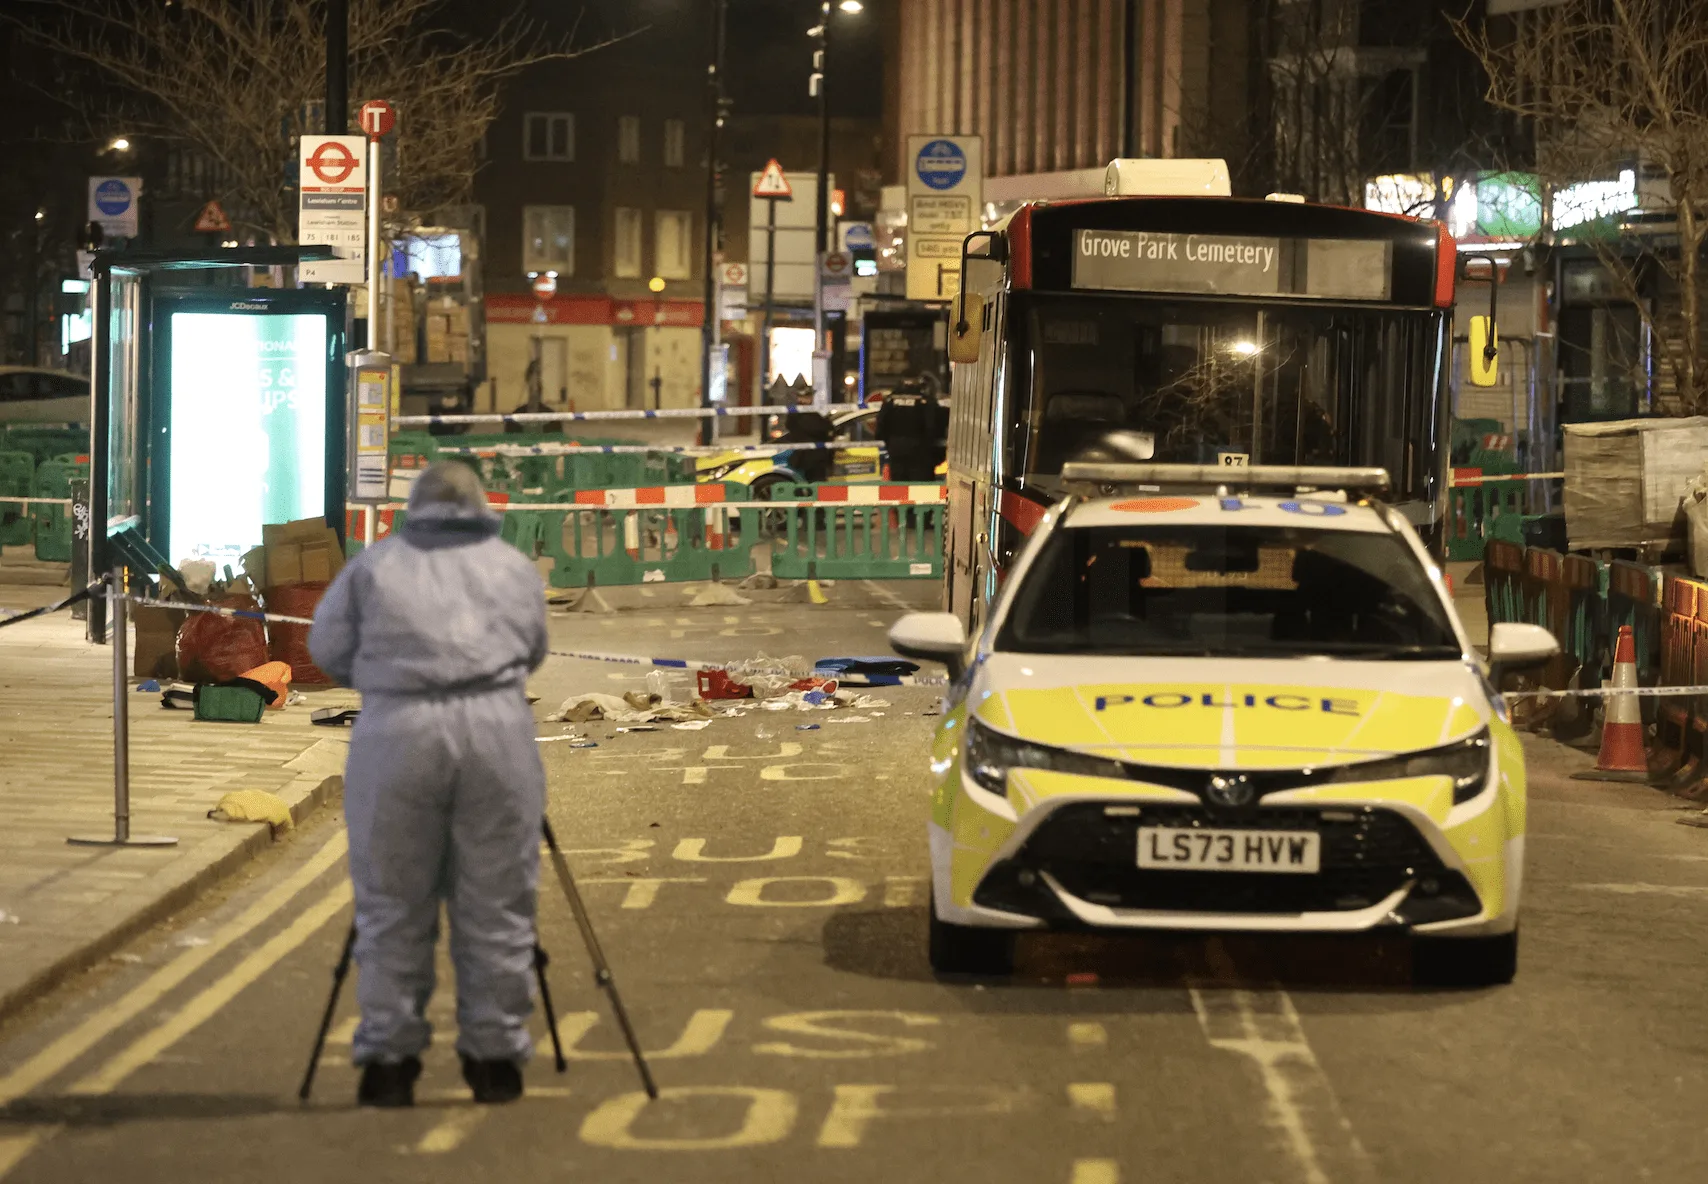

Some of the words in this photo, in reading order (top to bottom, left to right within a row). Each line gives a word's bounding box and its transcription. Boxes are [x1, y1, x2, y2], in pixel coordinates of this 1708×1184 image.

[367, 107, 387, 132] T
[306, 233, 316, 241] 75
[347, 234, 360, 242] 185
[1081, 230, 1130, 258] Grove
[1137, 231, 1178, 261] Park
[1186, 234, 1274, 272] Cemetery
[230, 302, 268, 310] JCDecaux
[1095, 692, 1361, 717] POLICE
[1150, 833, 1235, 864] LS73
[1244, 836, 1309, 864] HVW
